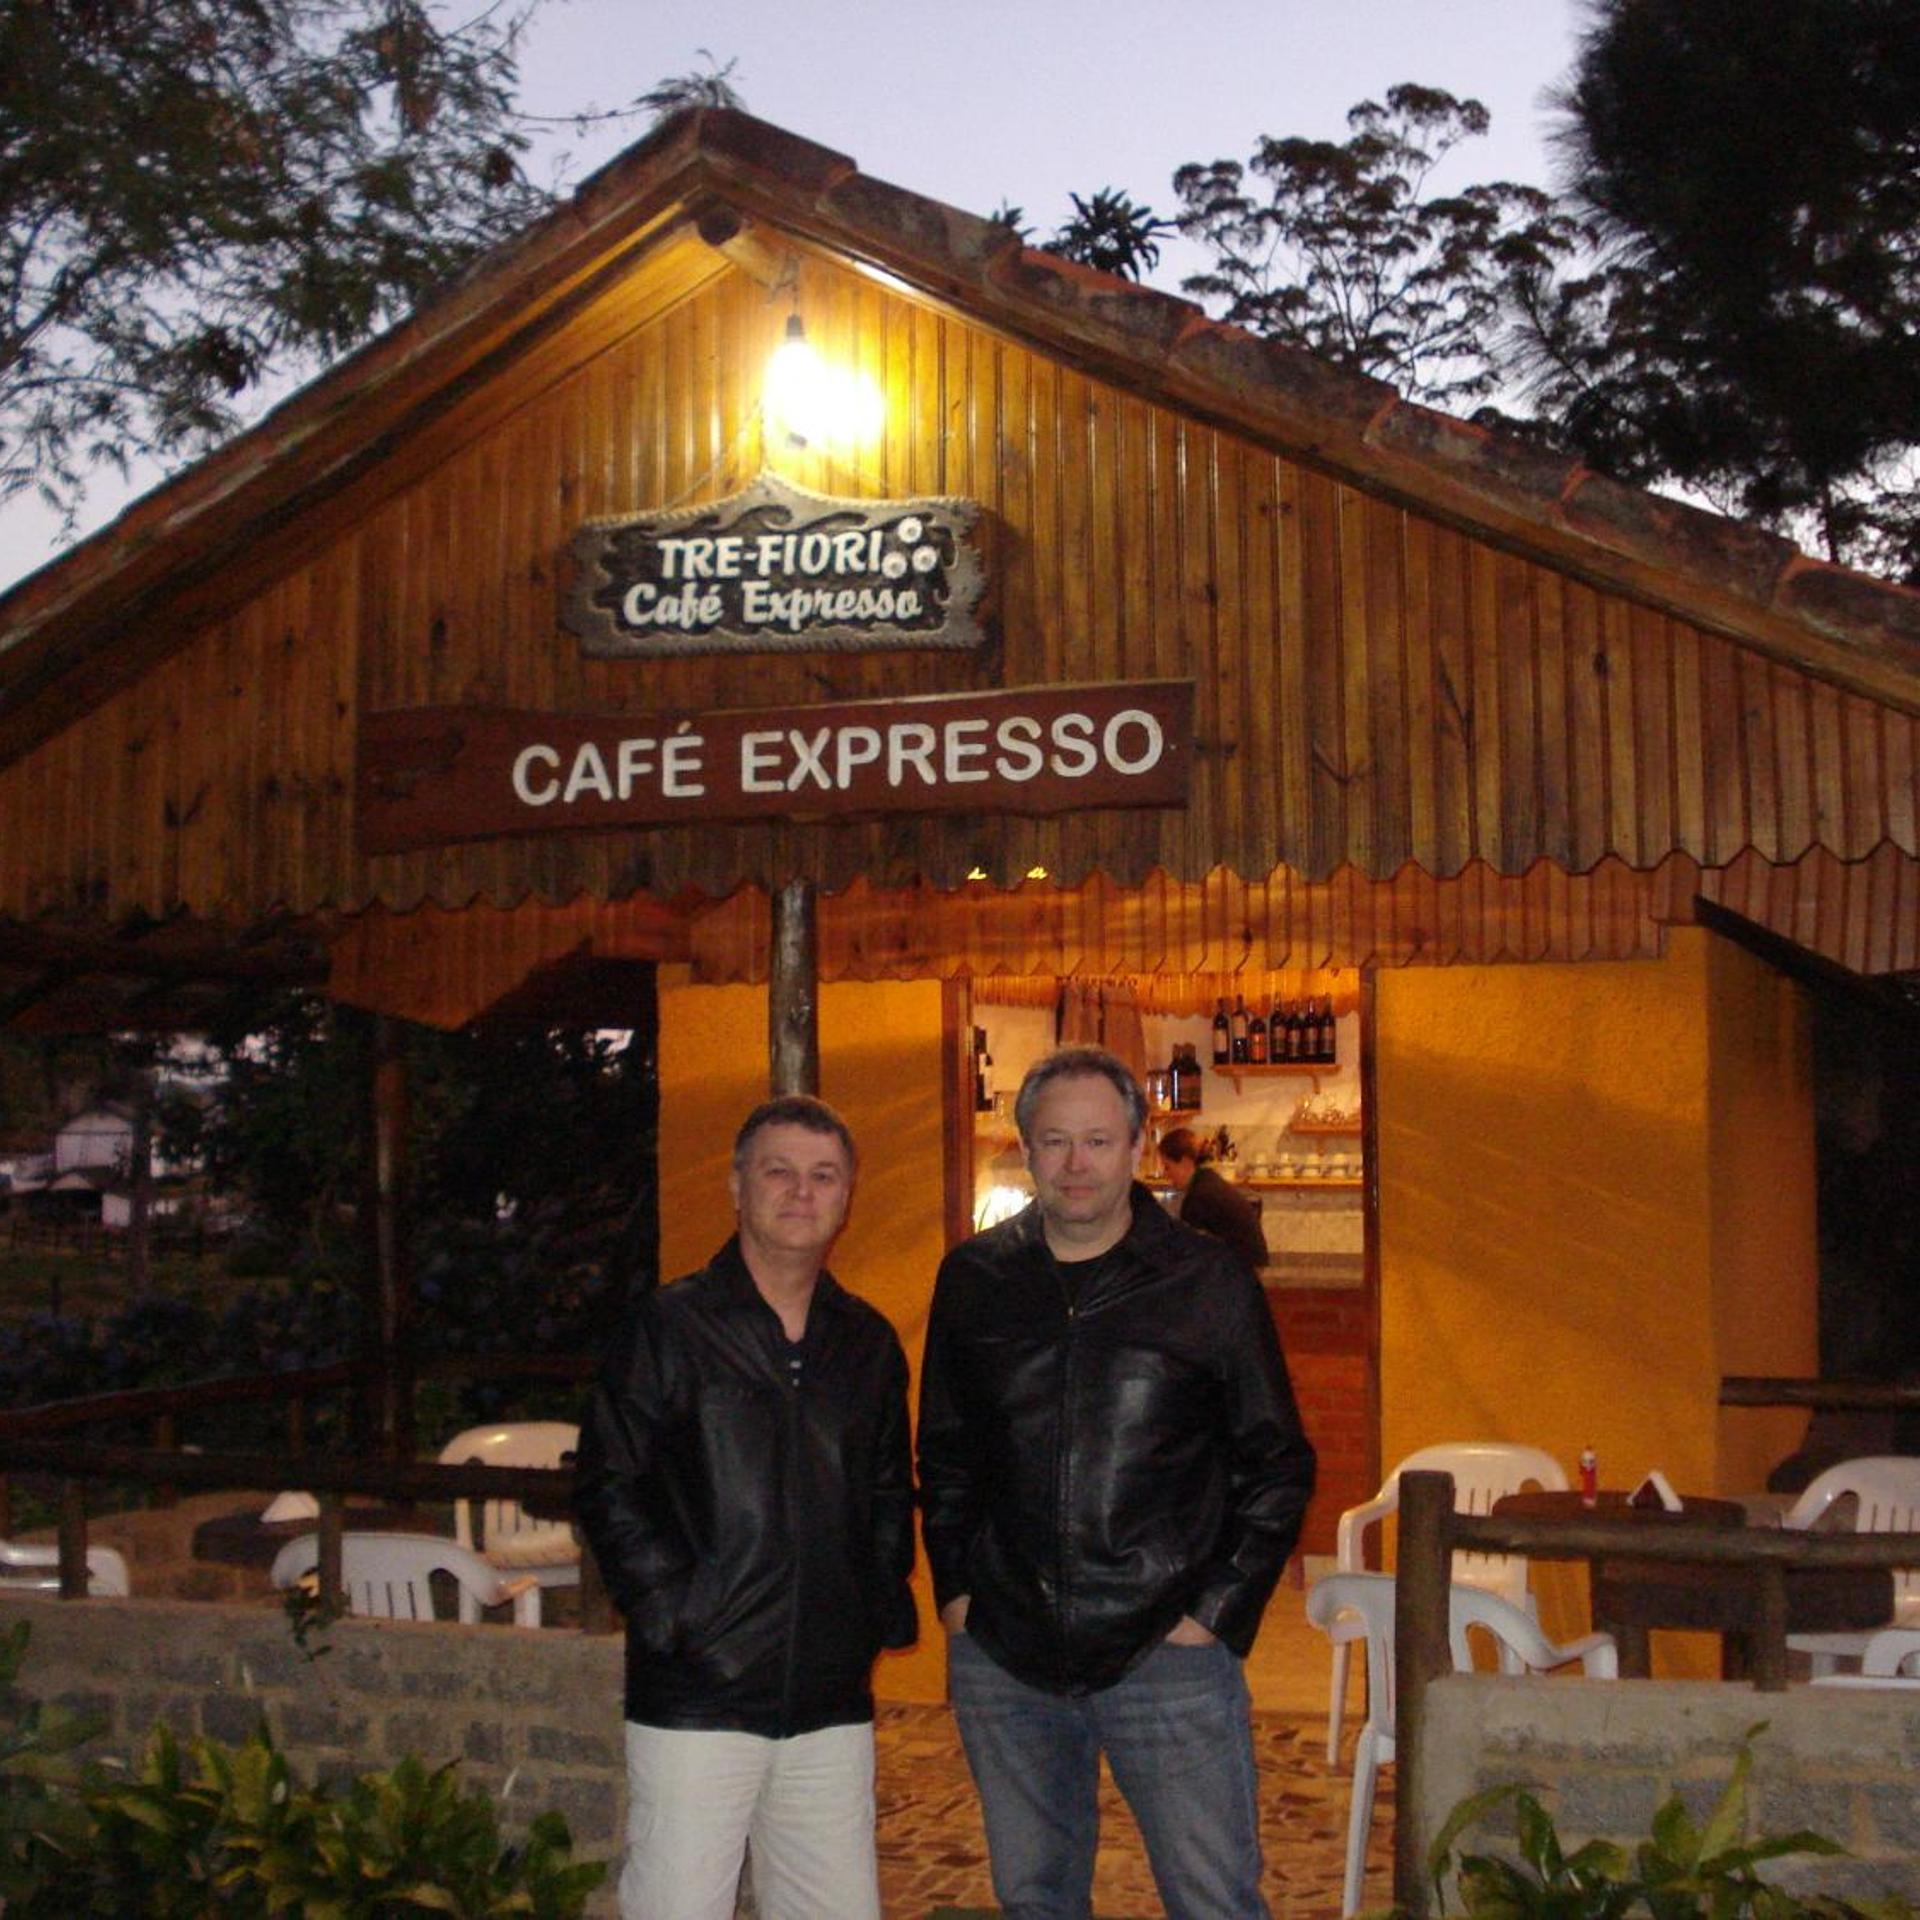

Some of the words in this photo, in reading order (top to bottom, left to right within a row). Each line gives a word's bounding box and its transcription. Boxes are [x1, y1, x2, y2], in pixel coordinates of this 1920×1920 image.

[657, 530, 882, 579] TRE-FIORI
[621, 581, 724, 630] Café
[740, 580, 923, 631] Expresso
[512, 720, 706, 807] CAFÉ
[740, 709, 1164, 793] EXPRESSO
